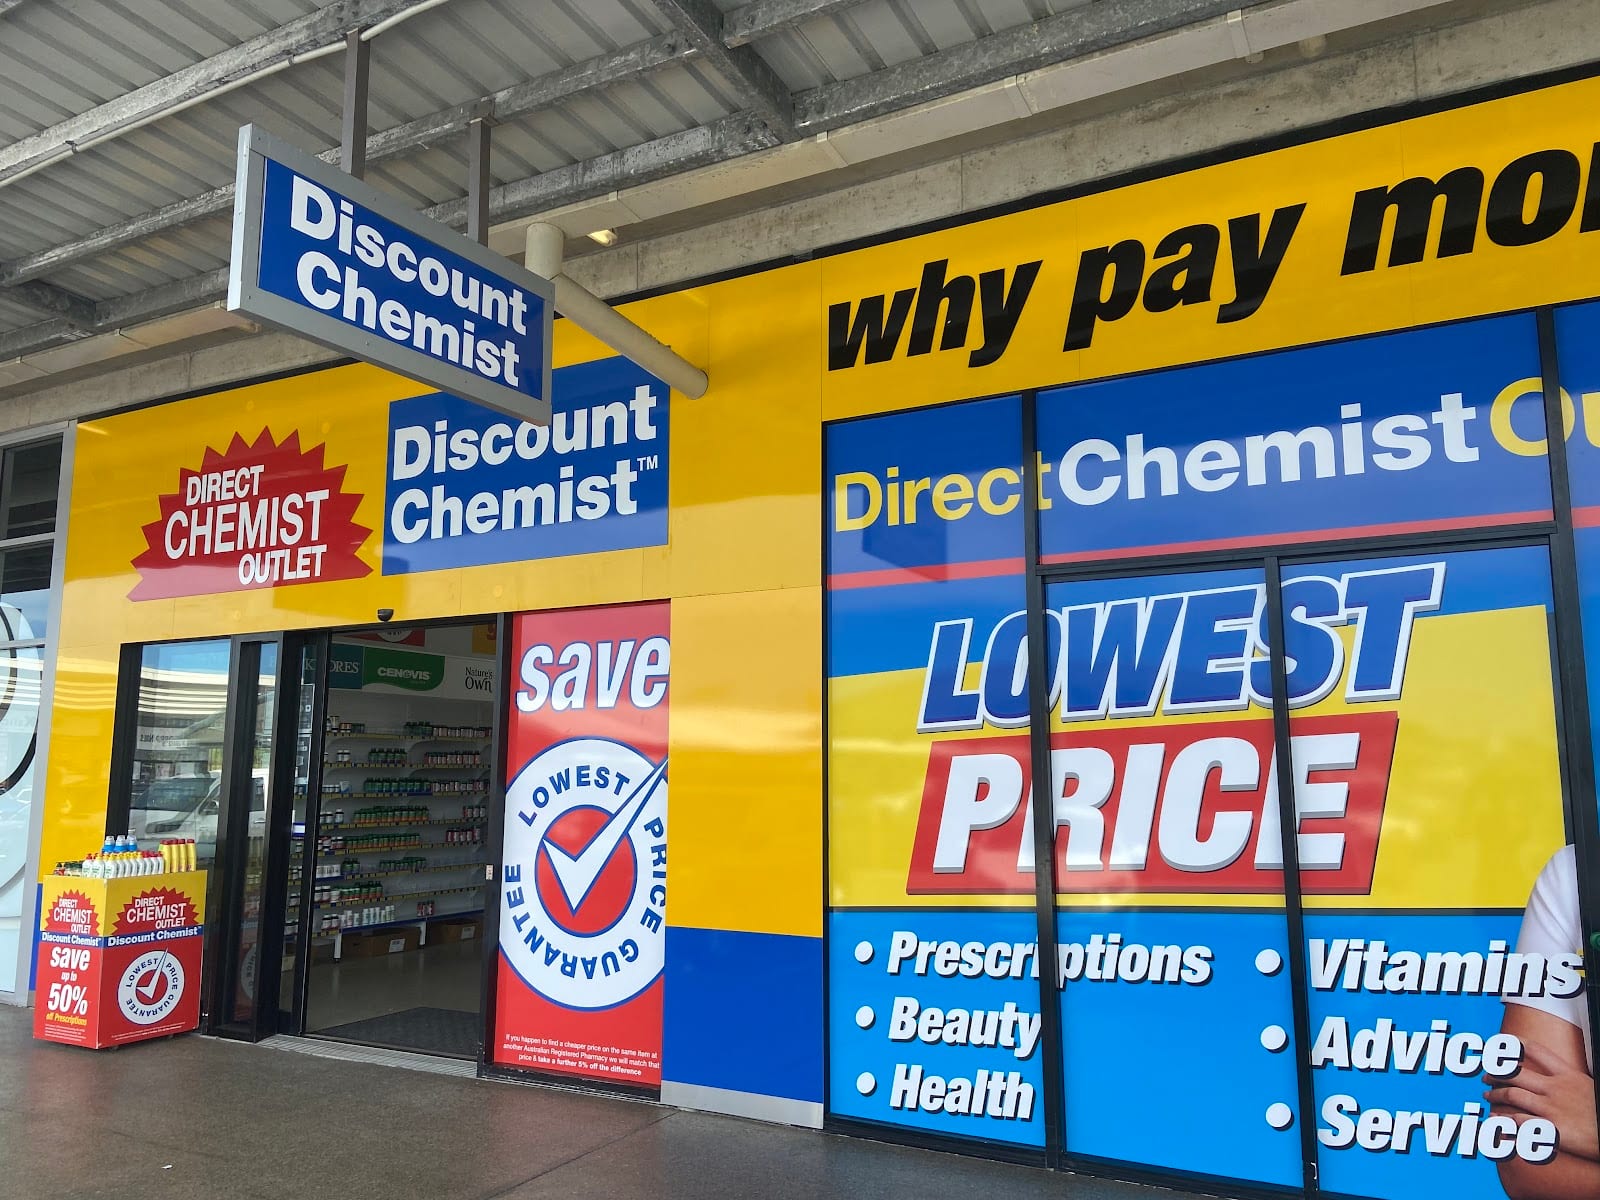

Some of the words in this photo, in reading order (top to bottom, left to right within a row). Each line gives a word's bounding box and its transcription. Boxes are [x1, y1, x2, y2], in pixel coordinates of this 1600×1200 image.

[290, 175, 527, 336] Discount
[828, 259, 1043, 371] why
[1063, 203, 1306, 352] pay
[296, 252, 520, 387] Chemist
[393, 384, 657, 480] Discount
[1057, 392, 1480, 506] Chemist
[186, 464, 265, 506] DIRECT
[391, 459, 638, 544] Chemist
[164, 489, 330, 560] CHEMIST
[238, 544, 327, 585] OUTLET
[916, 561, 1447, 734] LOWEST
[377, 666, 431, 681] CENOVIS
[465, 677, 492, 693] Own
[515, 636, 670, 714] save
[518, 765, 630, 827] LOWEST
[933, 732, 1361, 874] PRICE
[639, 816, 667, 935] PRICE
[53, 907, 92, 924] CHEMIST
[59, 898, 78, 908] DIRECT
[126, 903, 186, 923] CHEMIST
[135, 896, 165, 908] DIRECT
[41, 932, 70, 944] Discount
[71, 934, 98, 946] Chemist
[71, 923, 91, 934] OUTLET
[107, 932, 155, 947] Discount
[156, 926, 197, 940] Chemist
[155, 917, 186, 929] OUTLET
[504, 864, 640, 980] GUARANTEE
[50, 946, 90, 971] save
[61, 972, 70, 982] up
[70, 971, 77, 981] to
[126, 958, 158, 988] LOWEST
[166, 962, 179, 990] PRICE
[1308, 938, 1585, 998] Vitamins
[47, 983, 88, 1015] 50%
[126, 994, 174, 1017] GUARANTEE
[54, 1013, 87, 1026] Prescriptions
[888, 996, 1042, 1060] Beauty
[521, 1036, 540, 1044] happen
[564, 1041, 586, 1050] cheaper
[587, 1044, 601, 1052] price
[524, 1045, 549, 1054] Australian
[551, 1048, 579, 1058] Registered
[581, 1052, 608, 1063] Pharmacy
[629, 1059, 647, 1067] match
[648, 1061, 660, 1069] that
[1311, 1016, 1523, 1078] Advice
[538, 1055, 550, 1063] take
[557, 1059, 577, 1067] further
[589, 1062, 598, 1070] off
[610, 1066, 642, 1075] difference
[889, 1064, 1035, 1121] Health
[1317, 1094, 1558, 1163] Service
